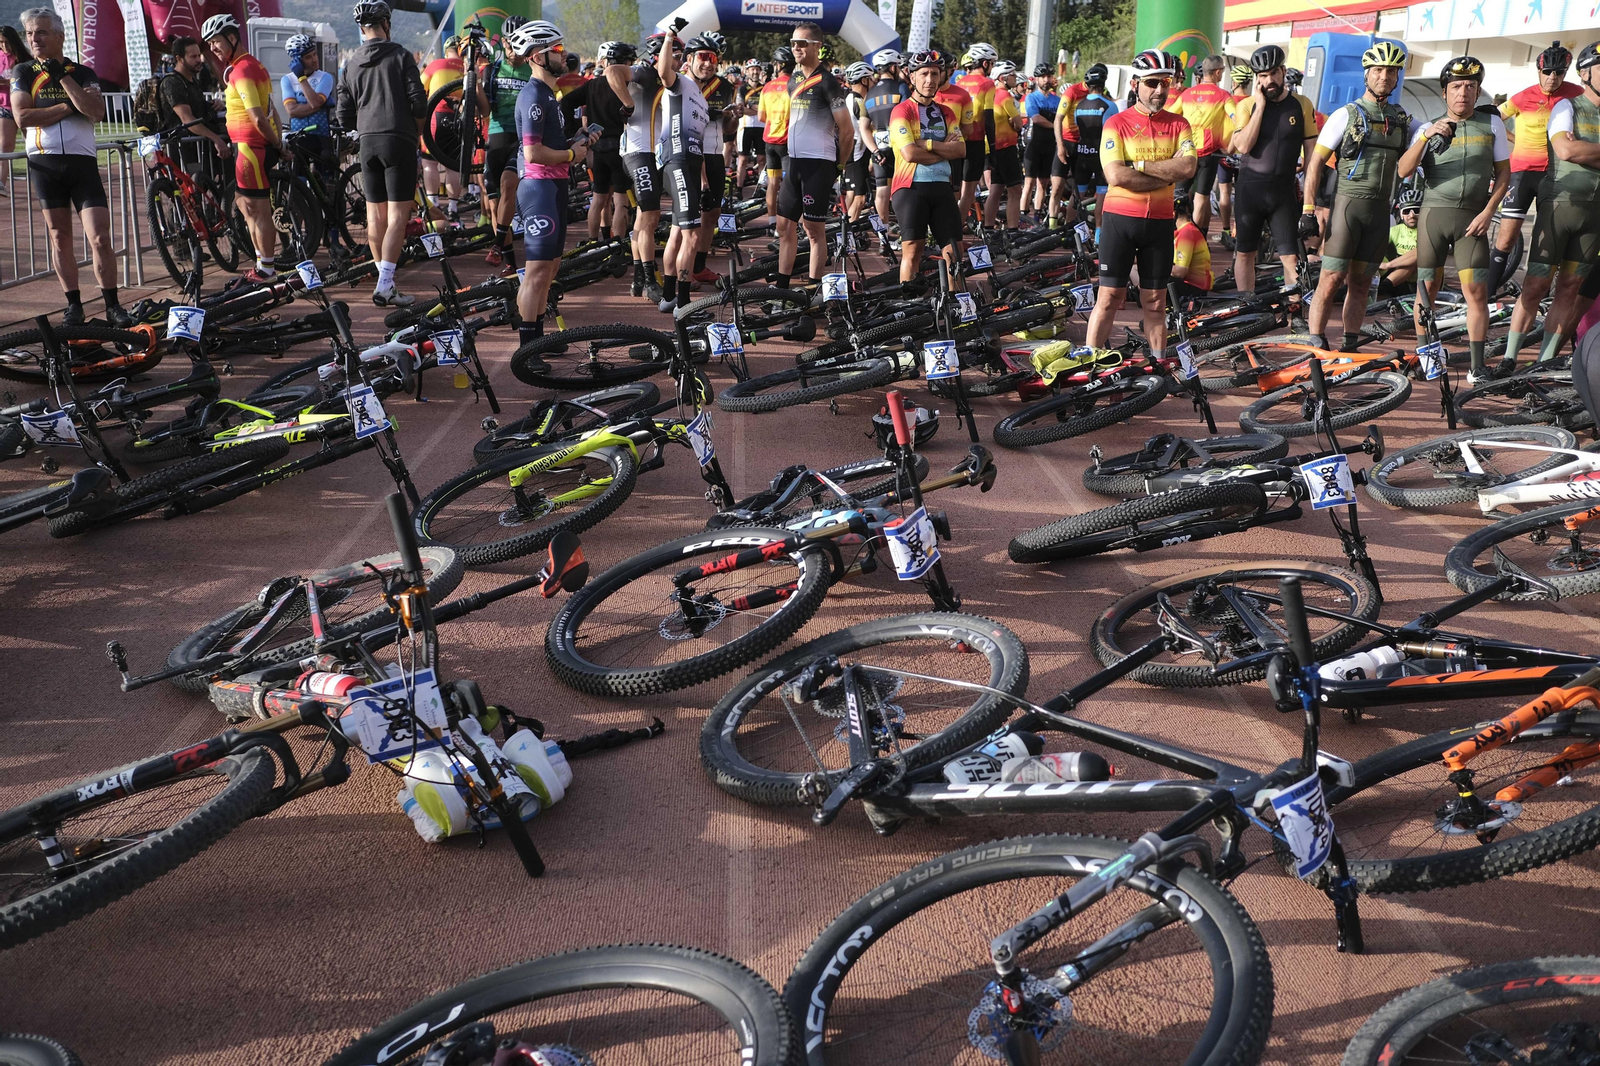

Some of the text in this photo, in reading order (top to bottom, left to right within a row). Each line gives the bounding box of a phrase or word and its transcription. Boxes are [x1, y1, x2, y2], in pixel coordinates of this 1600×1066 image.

[756, 2, 819, 15] INTERSPORT
[82, 0, 97, 64] IORELAX
[637, 166, 653, 192] BCCT
[934, 346, 947, 372] 8584
[825, 460, 863, 474] RENEGADE
[918, 625, 996, 653] VECTOR
[722, 669, 785, 737] VECTOR
[846, 691, 862, 738] SCOTT
[78, 775, 121, 801] FOX
[933, 781, 1161, 799] SCOTT
[901, 842, 1032, 893] RACING RAY
[805, 925, 875, 1054] VECTOR
